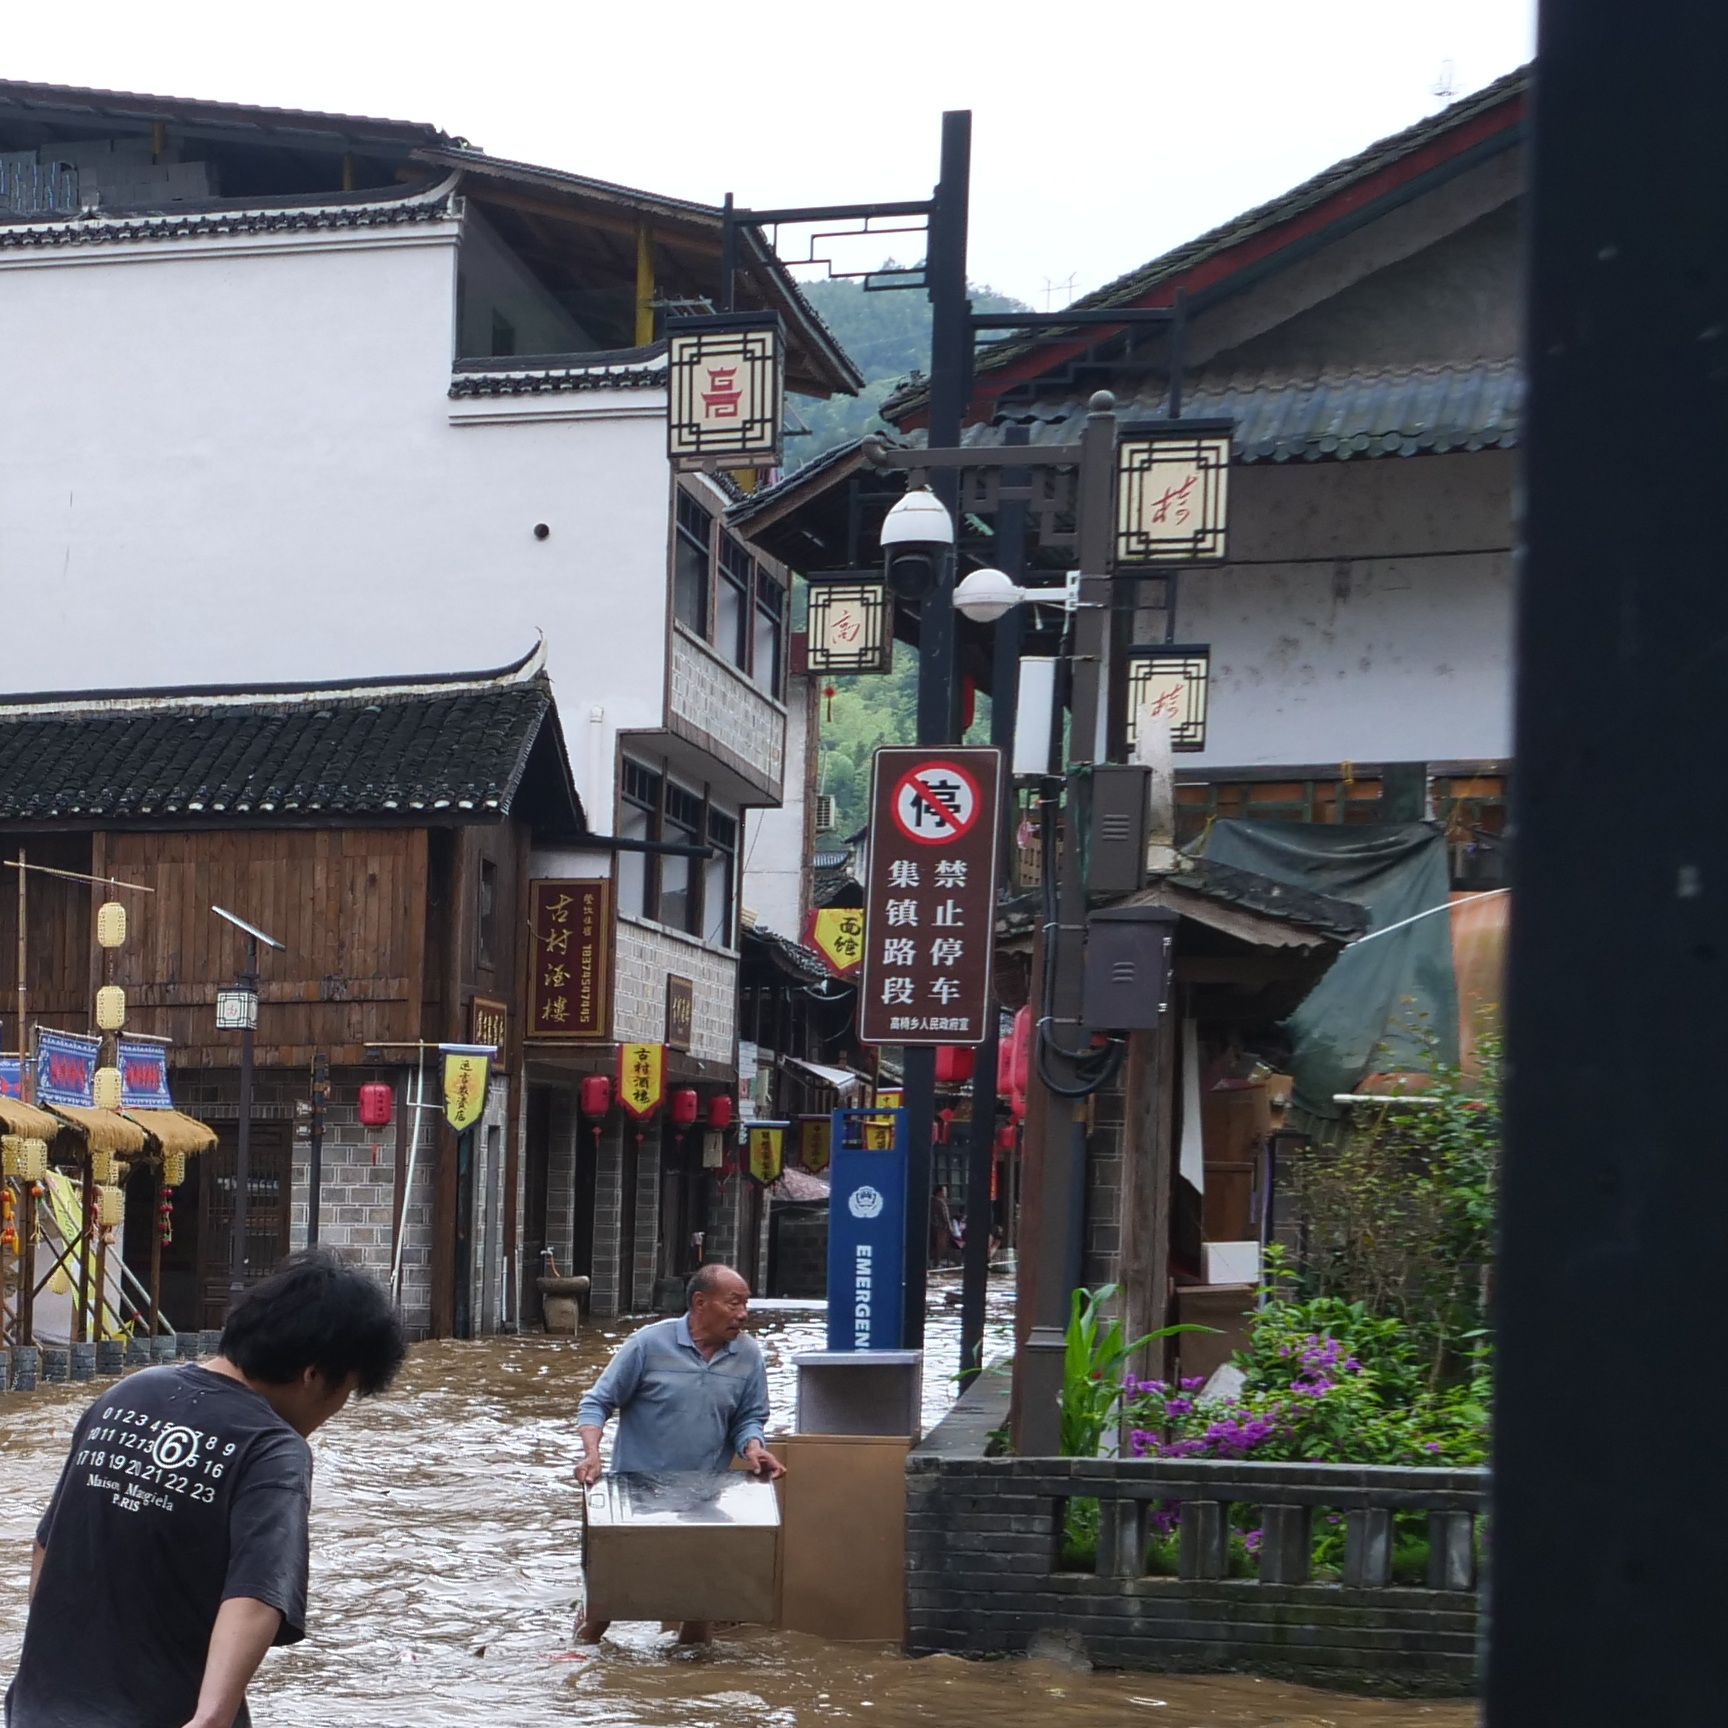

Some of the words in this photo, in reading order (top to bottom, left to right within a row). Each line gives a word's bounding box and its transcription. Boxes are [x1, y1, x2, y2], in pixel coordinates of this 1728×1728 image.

[881, 859, 921, 1005] 集镇路段
[927, 859, 969, 1005] 禁止停车
[854, 1244, 873, 1351] EMERGEN
[100, 1428, 117, 1442] 11
[118, 1432, 139, 1449] 12
[136, 1438, 155, 1453] 13
[203, 1460, 225, 1478] 16
[102, 1406, 114, 1420] 0
[114, 1408, 124, 1421] 1
[122, 1410, 136, 1424] 2
[135, 1414, 149, 1426] 3
[149, 1420, 162, 1433] 4
[205, 1436, 218, 1450] 8
[222, 1443, 236, 1456] 9
[76, 1450, 90, 1466] 17
[90, 1451, 106, 1466] 18
[109, 1453, 126, 1470] 19
[125, 1459, 142, 1477] 20
[141, 1465, 163, 1484] 21
[164, 1473, 189, 1494] 22
[190, 1482, 216, 1503] 23
[111, 1492, 141, 1512] PRIS
